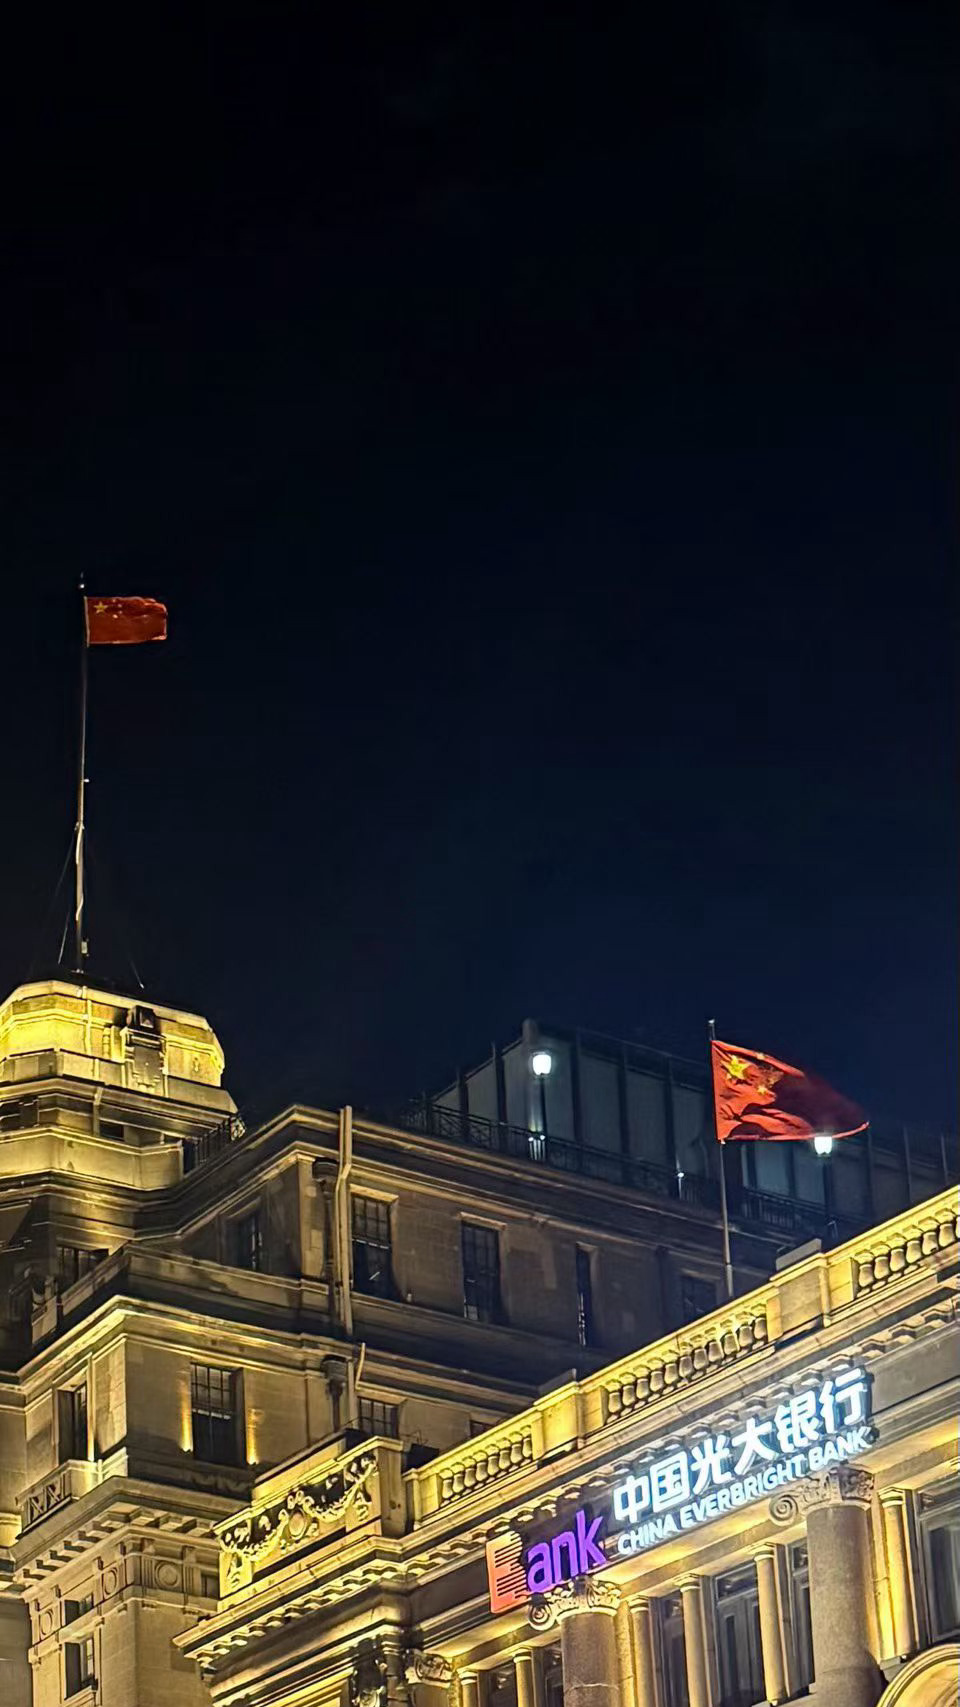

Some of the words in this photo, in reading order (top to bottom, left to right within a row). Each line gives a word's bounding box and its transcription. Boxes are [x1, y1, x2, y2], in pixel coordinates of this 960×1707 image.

[613, 1368, 867, 1524] 中国光大银行
[617, 1511, 680, 1556] CHINA
[680, 1455, 807, 1529] EVERBRIGHT
[808, 1426, 872, 1472] BANK
